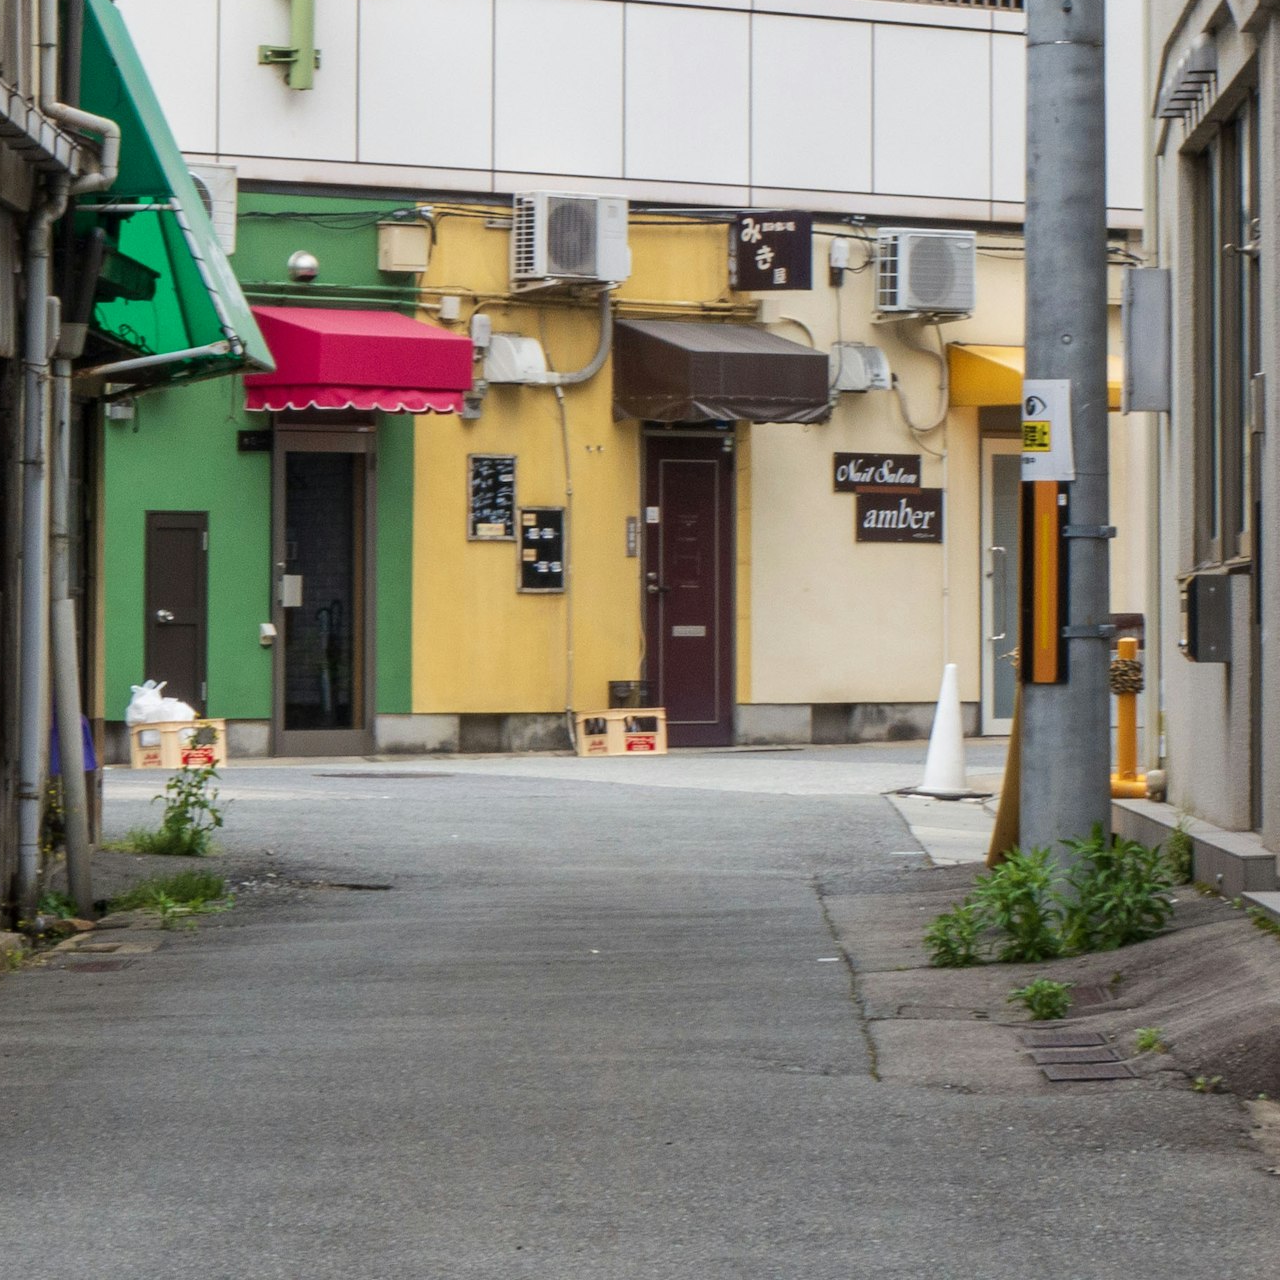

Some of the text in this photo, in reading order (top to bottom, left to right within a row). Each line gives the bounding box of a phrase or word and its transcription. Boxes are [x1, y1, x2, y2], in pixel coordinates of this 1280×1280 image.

[836, 458, 918, 485] Nail Salon
[863, 497, 936, 530] amber
